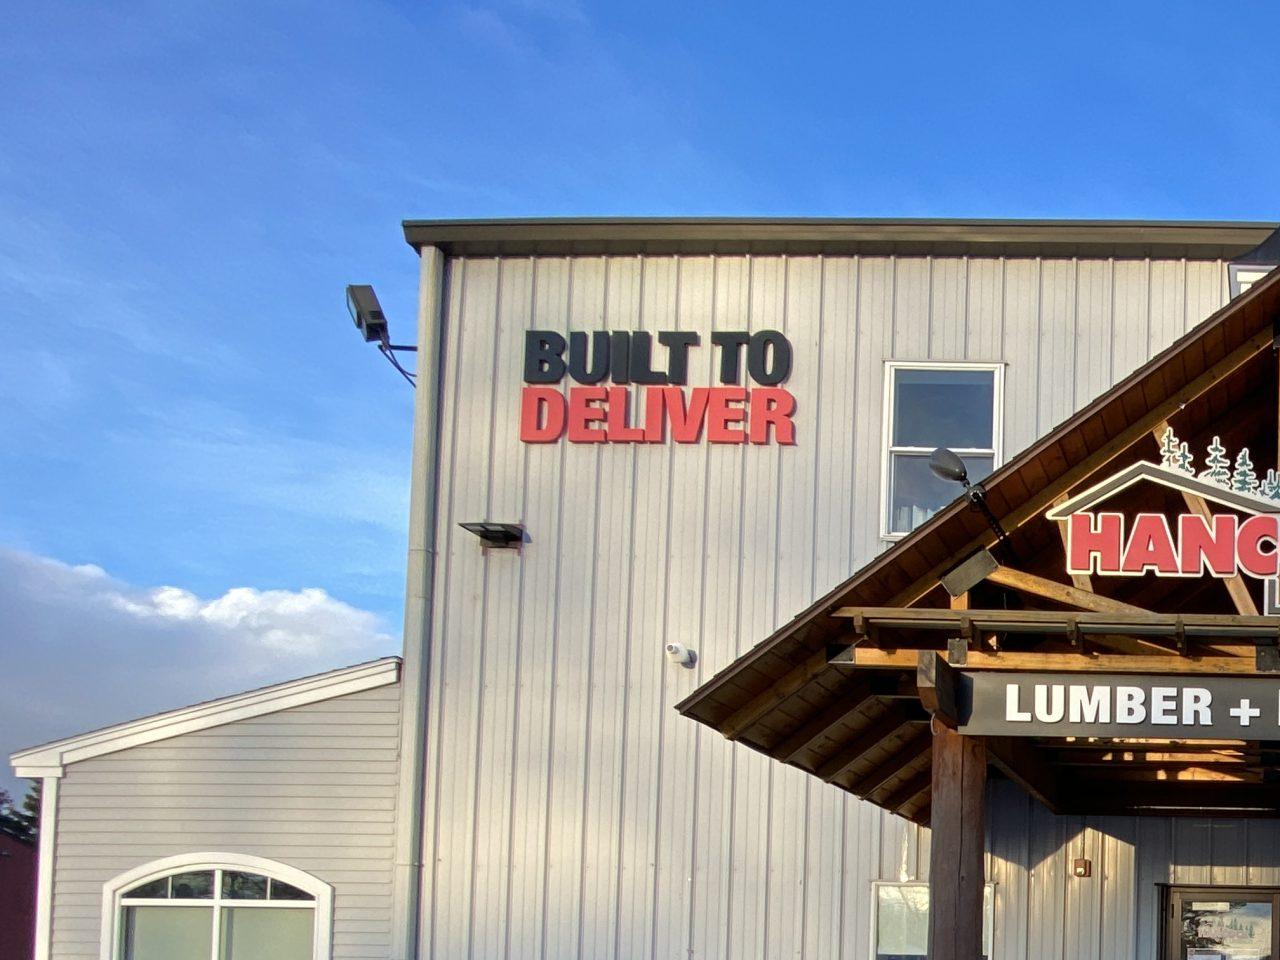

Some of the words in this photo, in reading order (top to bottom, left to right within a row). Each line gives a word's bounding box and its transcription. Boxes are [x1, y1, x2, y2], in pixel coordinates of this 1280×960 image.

[524, 329, 701, 385] BUILT
[711, 329, 793, 386] TO
[520, 387, 798, 445] DELIVER
[1005, 683, 1213, 726] LUMBER
